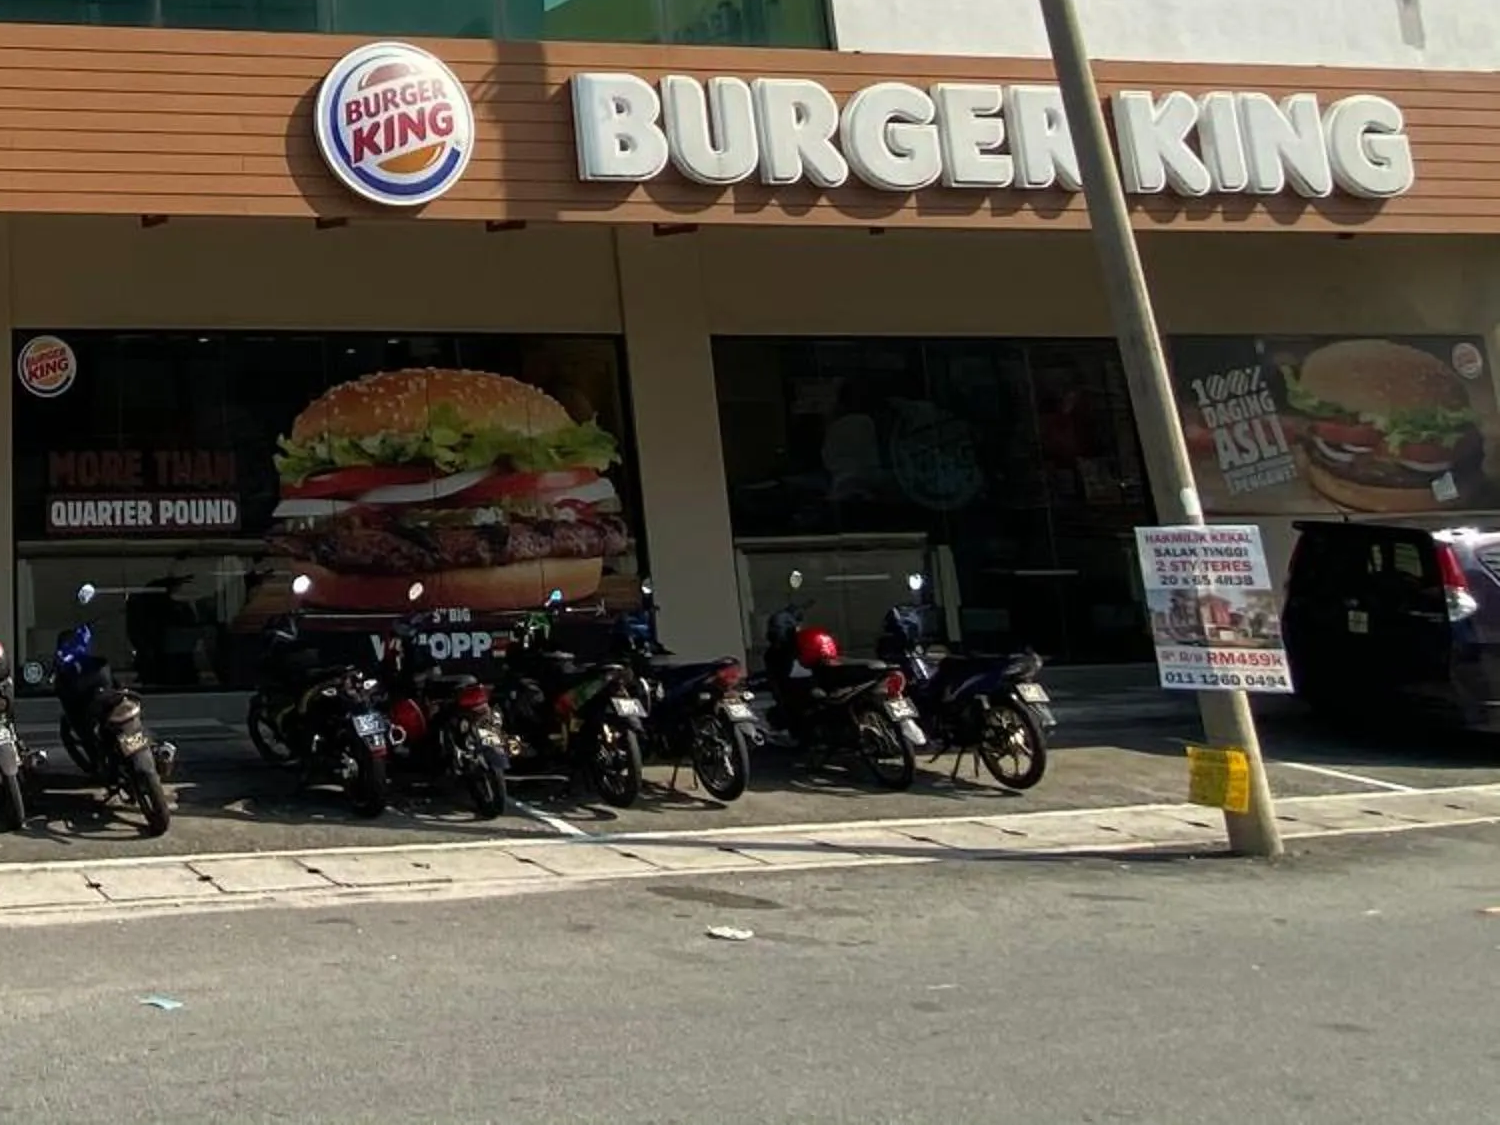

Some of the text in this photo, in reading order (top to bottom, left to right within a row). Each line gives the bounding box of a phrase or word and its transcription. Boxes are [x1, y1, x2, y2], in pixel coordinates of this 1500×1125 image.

[345, 77, 448, 126] BURGER
[352, 102, 455, 164] KING
[572, 71, 1416, 200] BURGER KING
[28, 357, 70, 382] KING
[1190, 366, 1268, 406] 100%
[1201, 390, 1278, 429] DAGING
[1213, 415, 1290, 471] ASLI
[48, 449, 237, 488] MORE THAN
[50, 498, 238, 527] QUARTER POUND
[1153, 546, 1249, 558] SALAK TINGGI
[1155, 559, 1253, 572] 2 STY TERES
[1160, 575, 1178, 586] 20
[449, 608, 472, 623] BIG
[1165, 672, 1195, 684] 011
[1200, 673, 1241, 686] 1260
